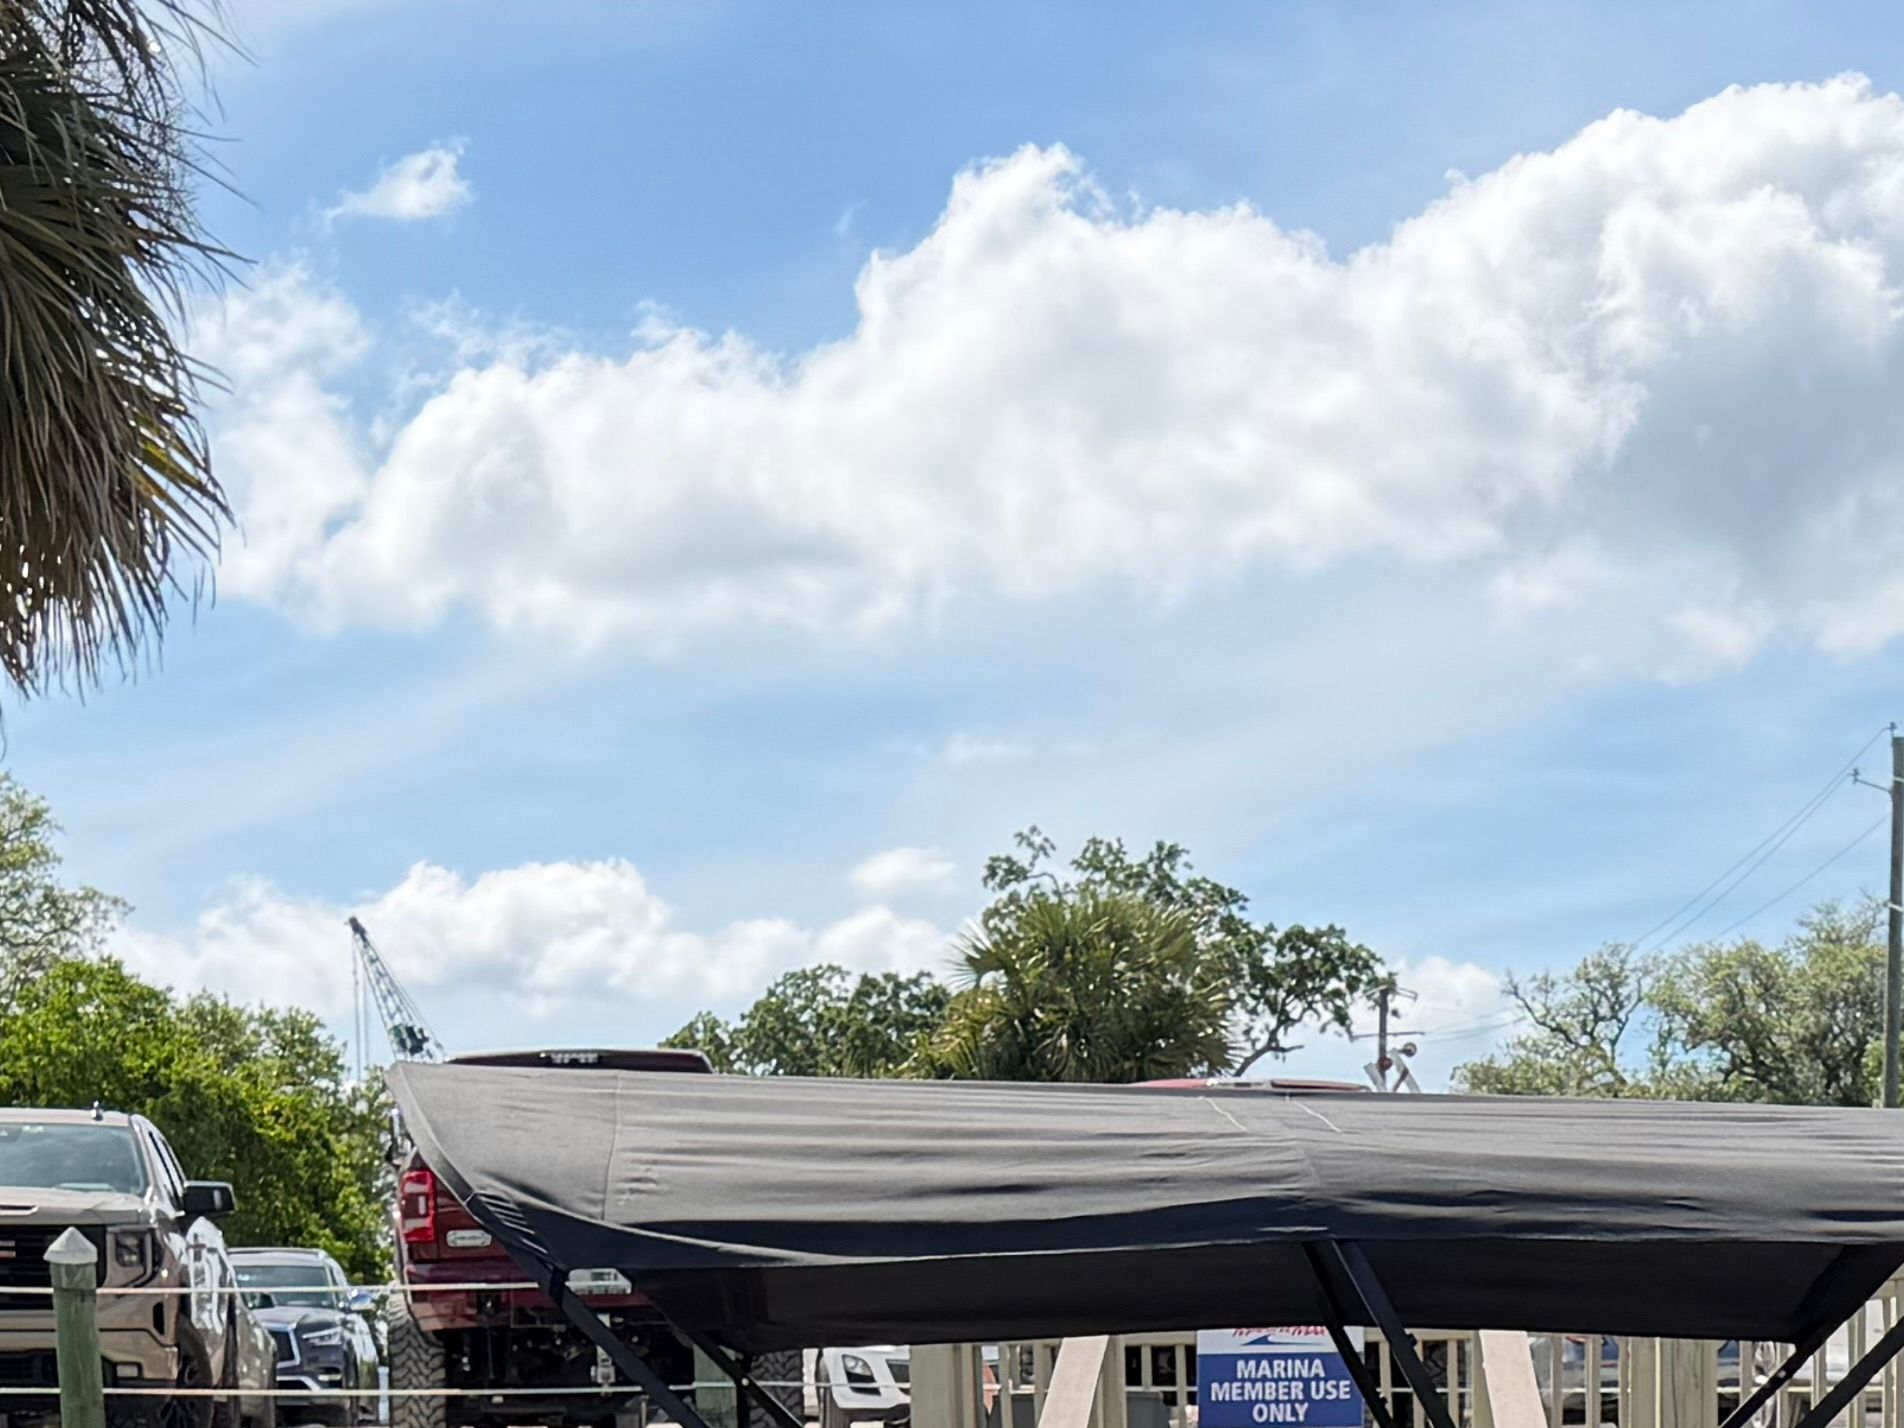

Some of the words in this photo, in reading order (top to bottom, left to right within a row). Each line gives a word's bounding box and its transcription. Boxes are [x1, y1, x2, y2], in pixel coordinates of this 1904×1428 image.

[1236, 1358, 1326, 1380] MARINA
[1210, 1380, 1304, 1402] MEMBER
[1310, 1379, 1352, 1400] USE
[1252, 1402, 1309, 1423] ONLY
